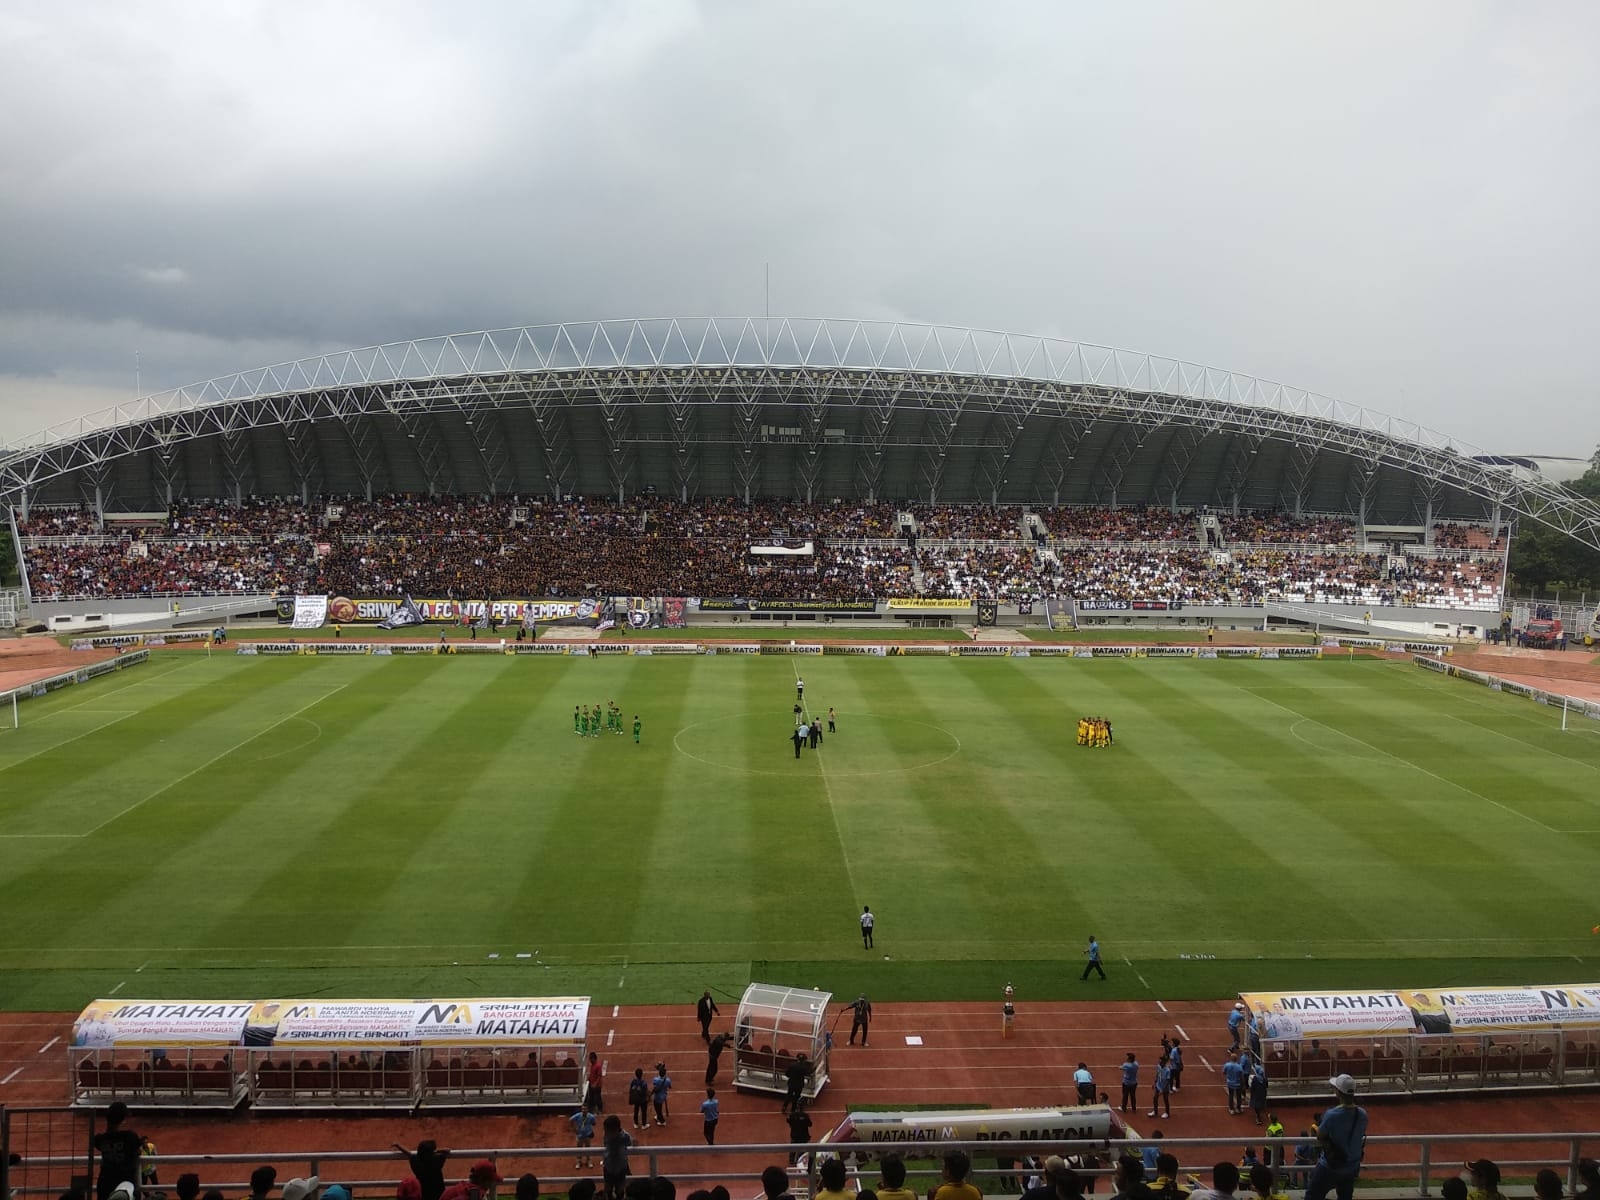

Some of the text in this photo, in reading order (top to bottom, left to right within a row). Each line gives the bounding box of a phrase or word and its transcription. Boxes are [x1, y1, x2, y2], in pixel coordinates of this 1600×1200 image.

[435, 603, 453, 618] FC
[491, 603, 518, 618] PER
[92, 636, 139, 647] MATAHATI
[1405, 643, 1449, 653] MATAHATI
[1280, 995, 1404, 1010] MATAHATI
[113, 1005, 253, 1018] MATAHATI
[528, 1010, 575, 1018] BERSAMA
[476, 1019, 579, 1035] MATAHATI
[1463, 1016, 1513, 1025] SRIWIJAYA
[871, 1128, 937, 1142] MATAHATI
[1020, 1126, 1094, 1140] MATCH
